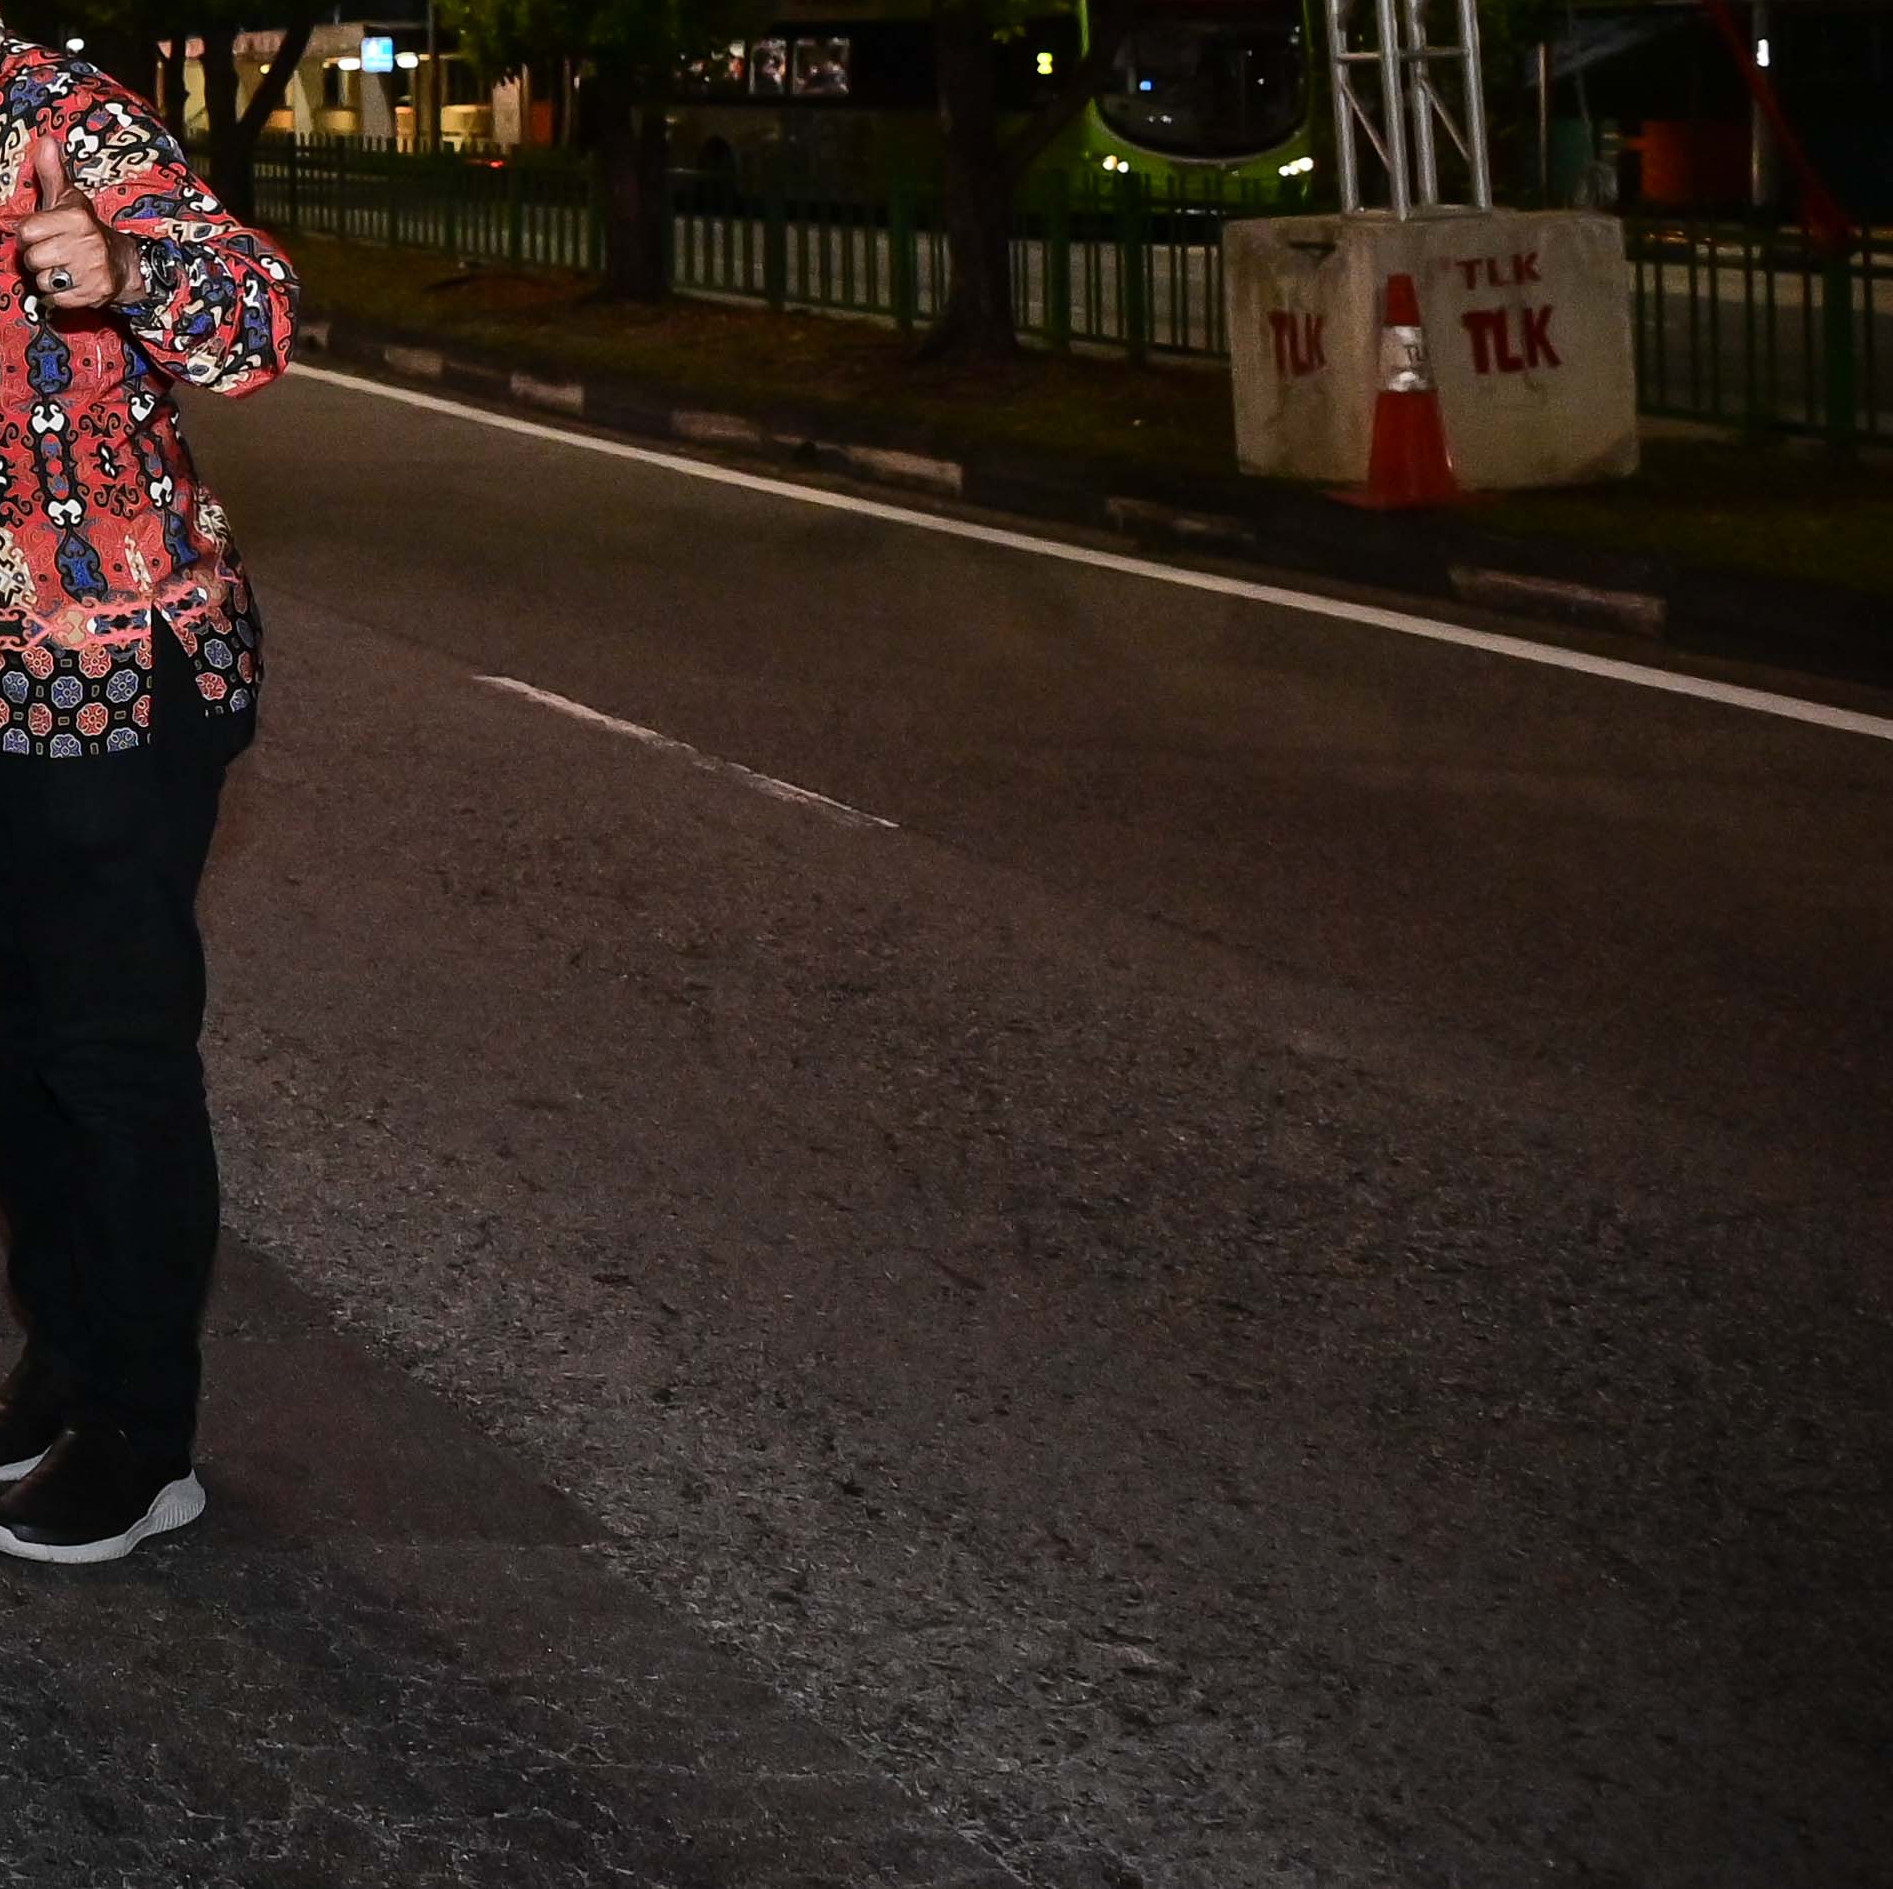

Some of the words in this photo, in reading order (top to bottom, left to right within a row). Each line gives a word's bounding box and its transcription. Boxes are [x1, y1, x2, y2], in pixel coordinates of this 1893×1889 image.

[1456, 252, 1542, 290] TLK
[1268, 310, 1326, 376] TLK
[1461, 303, 1562, 374] TLK
